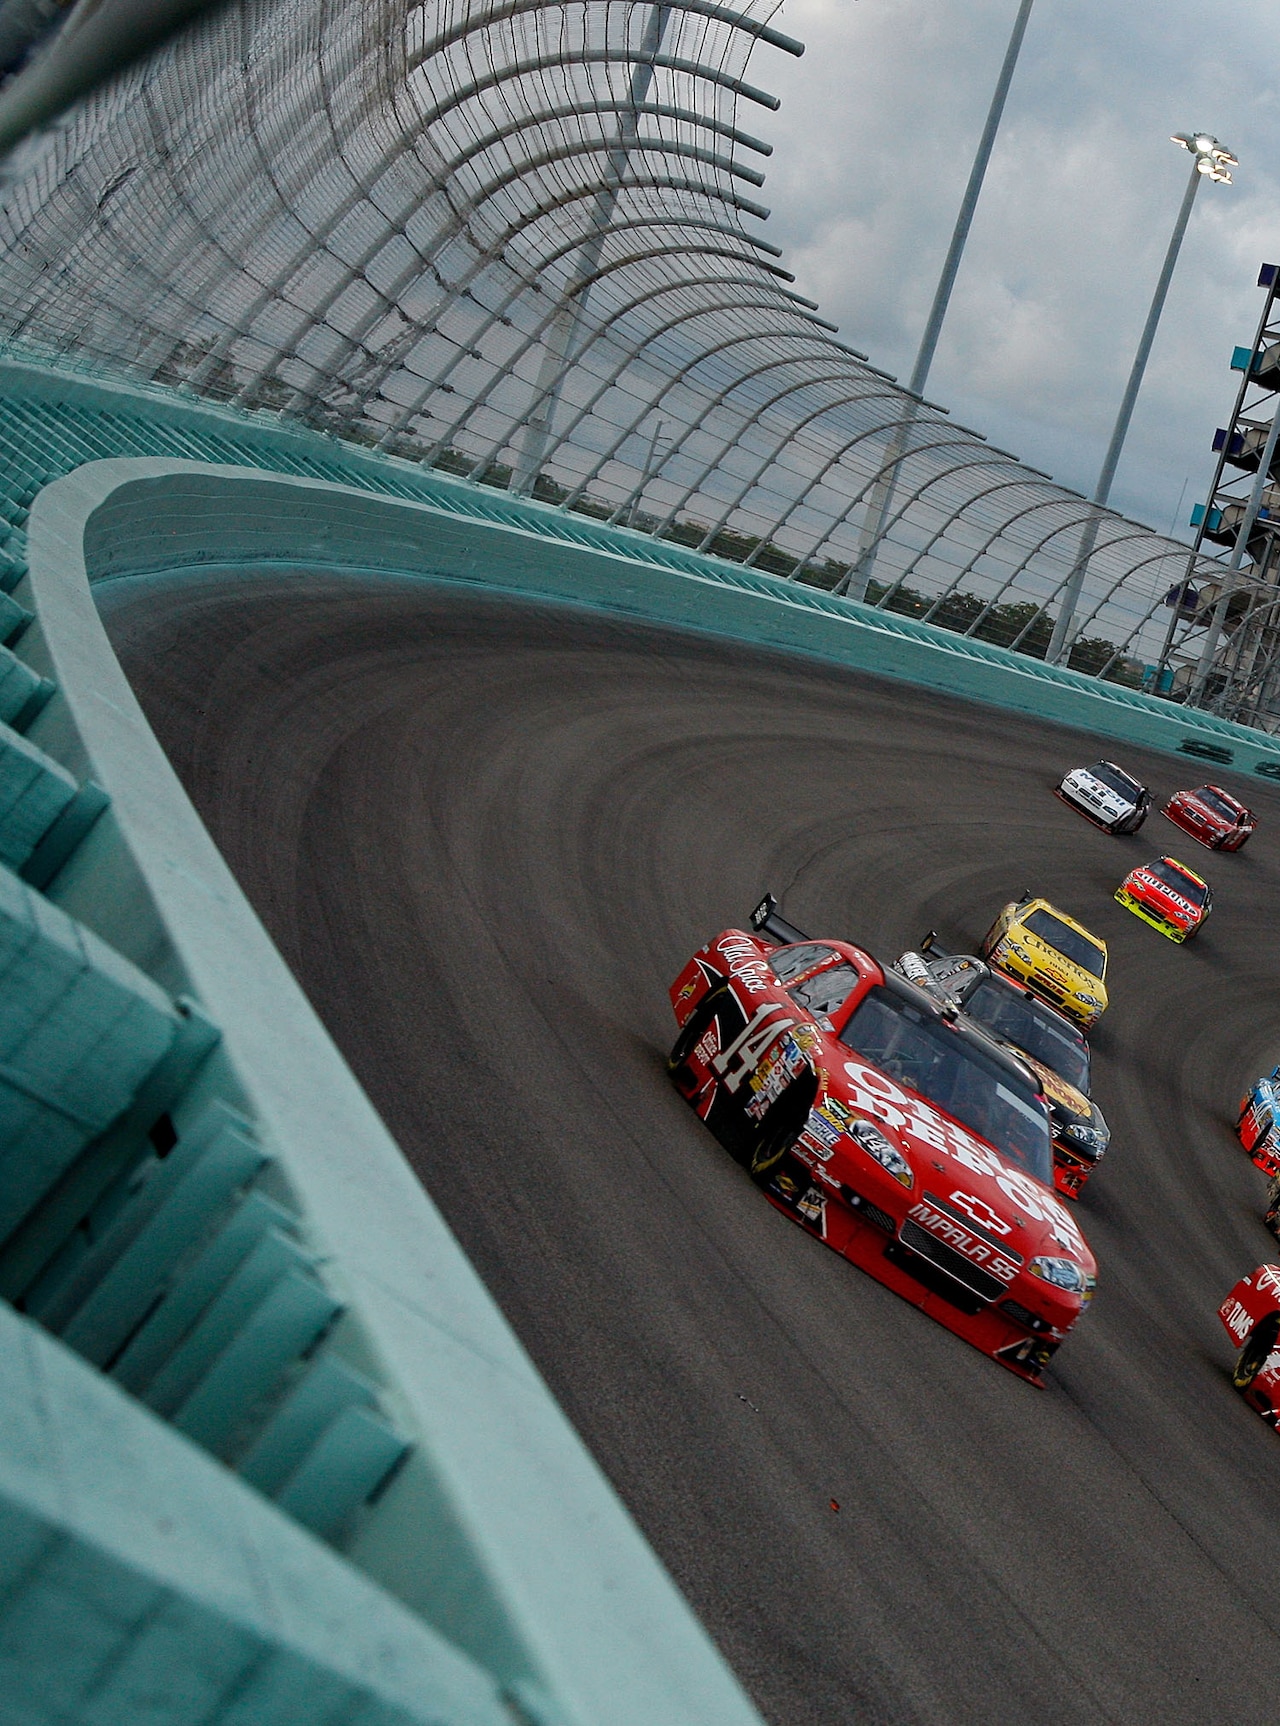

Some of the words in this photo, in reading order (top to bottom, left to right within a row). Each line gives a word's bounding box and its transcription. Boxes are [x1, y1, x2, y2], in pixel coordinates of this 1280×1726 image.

[717, 936, 756, 963] Old
[1022, 934, 1097, 991] Cheerios
[729, 959, 769, 994] Spice
[711, 1003, 795, 1094] 14
[817, 1106, 848, 1134] MOOG
[858, 1131, 886, 1154] 14
[848, 1083, 1085, 1263] DEPOT
[908, 1203, 992, 1262] IMPALA
[987, 1255, 1020, 1282] SS
[1226, 1302, 1255, 1340] TUMS
